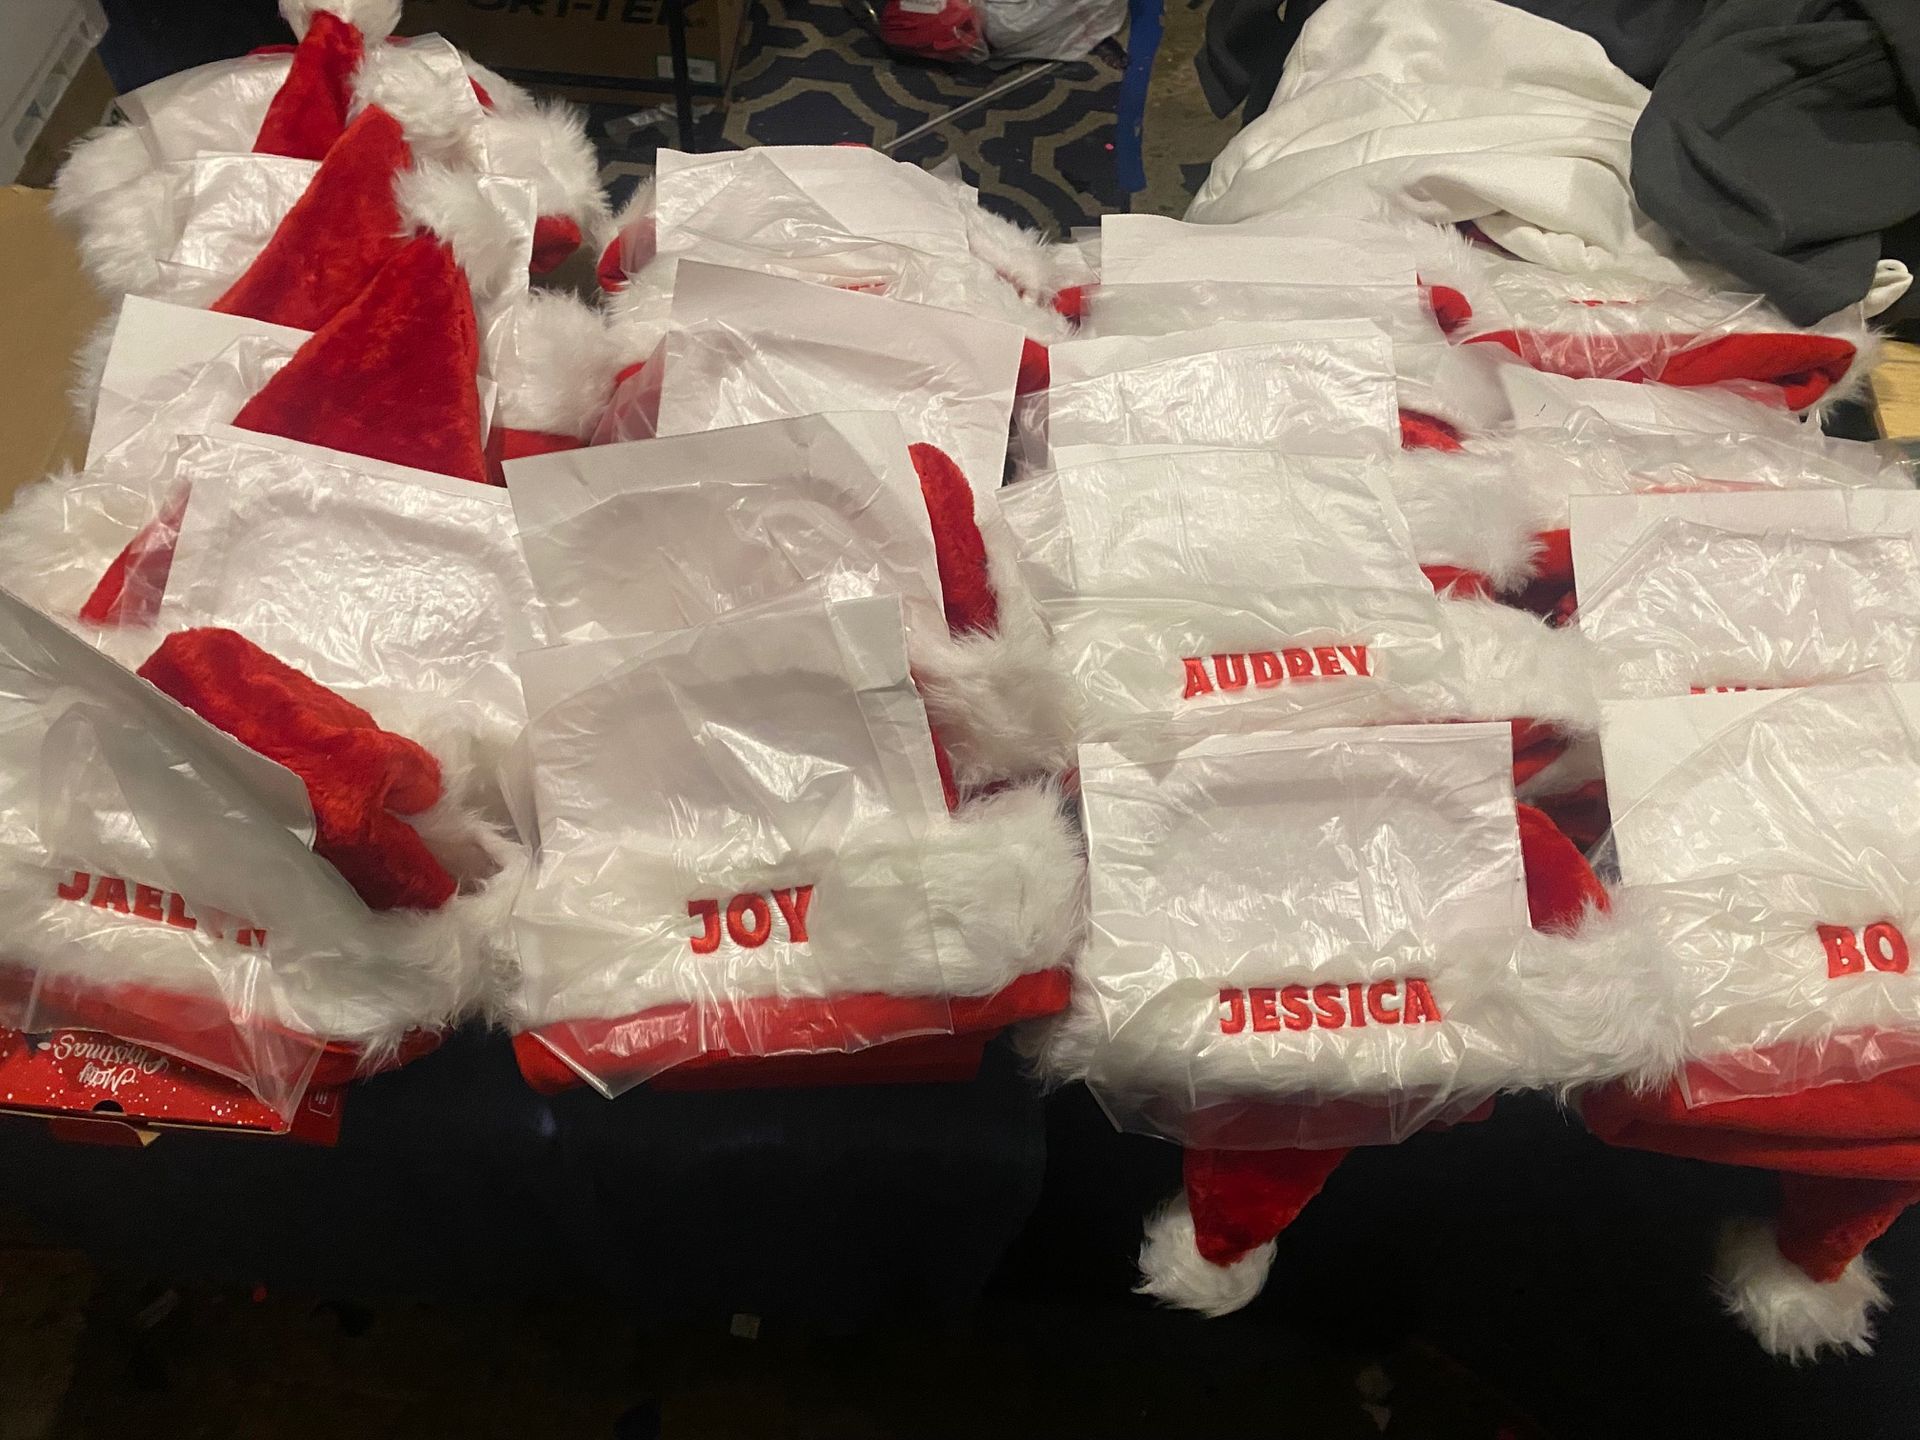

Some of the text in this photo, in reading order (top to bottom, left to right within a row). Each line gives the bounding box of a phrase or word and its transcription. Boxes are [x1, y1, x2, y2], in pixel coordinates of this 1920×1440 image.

[1182, 645, 1371, 699] AUDREY
[688, 885, 814, 954] JOY
[1816, 922, 1910, 978] BO
[1219, 978, 1441, 1034] JESSICA
